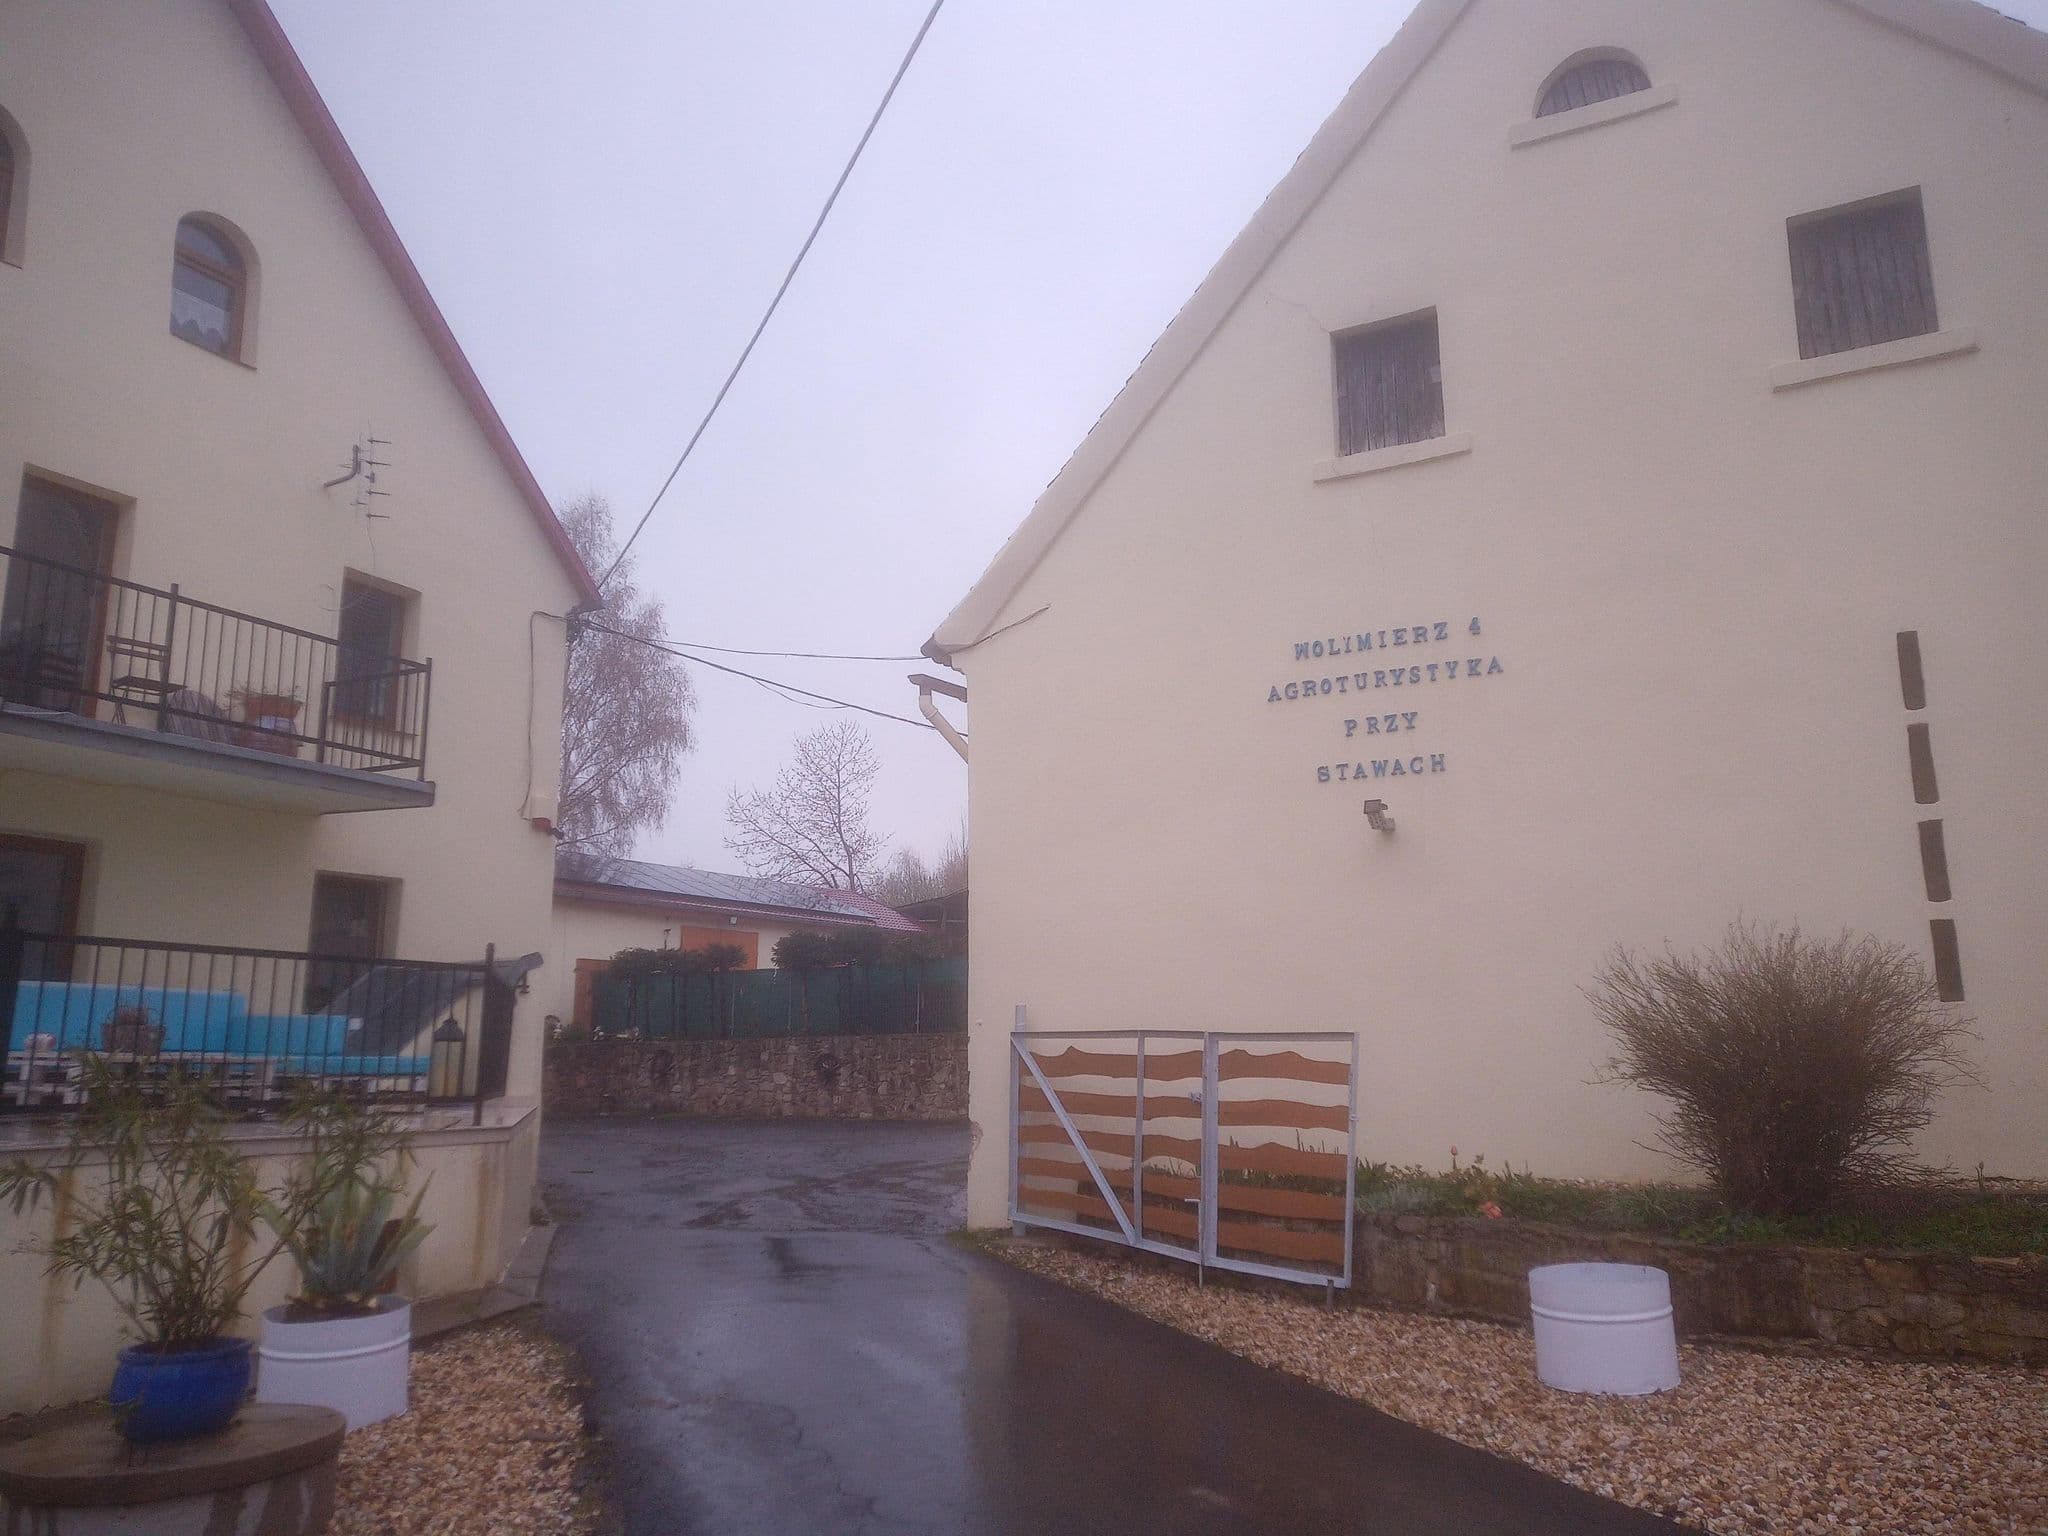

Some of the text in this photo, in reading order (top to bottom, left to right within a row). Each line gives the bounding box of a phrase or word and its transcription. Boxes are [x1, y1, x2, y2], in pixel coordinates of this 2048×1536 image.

[1468, 616, 1481, 635] 4
[1267, 655, 1504, 702] AGROTURYSTYKA
[1344, 711, 1418, 737] PRZY
[1316, 753, 1447, 782] STAWACH
